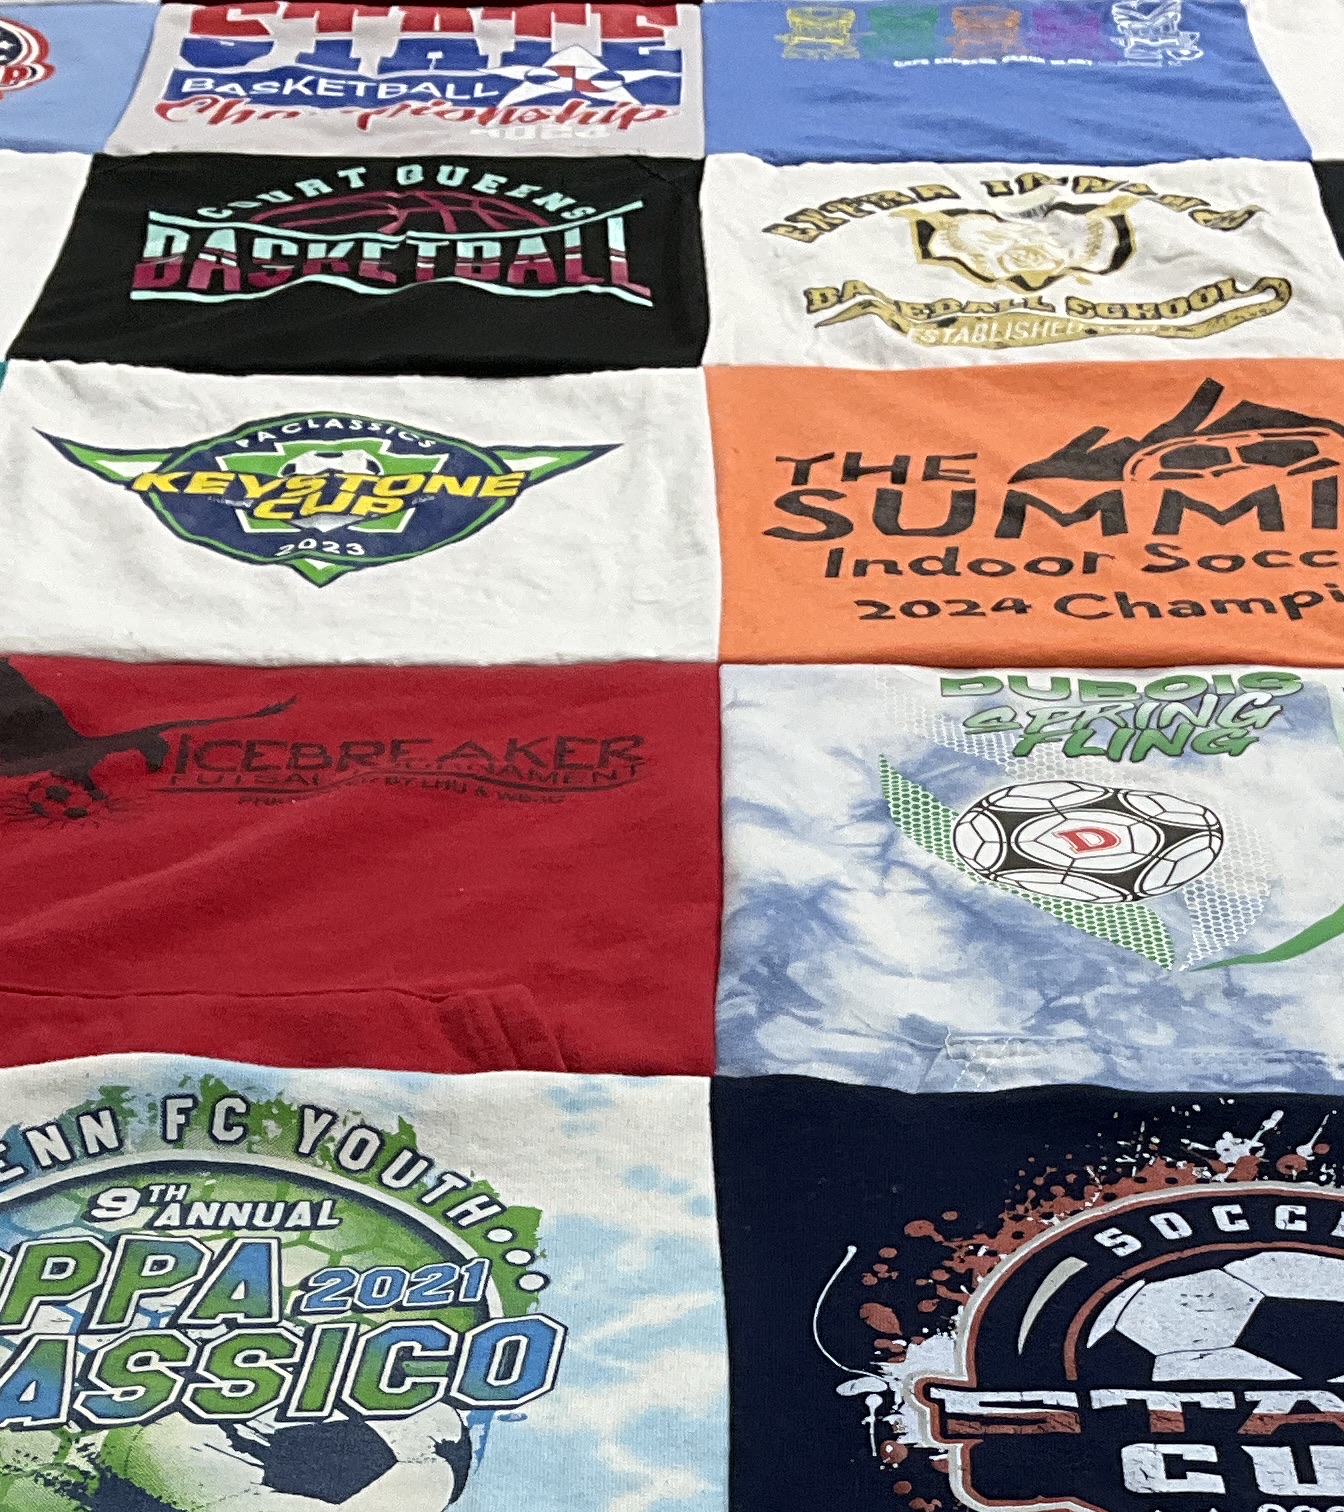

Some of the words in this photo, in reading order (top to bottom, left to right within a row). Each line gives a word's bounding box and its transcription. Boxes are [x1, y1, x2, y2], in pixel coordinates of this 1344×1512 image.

[180, 76, 501, 100] BASKETBALL
[156, 96, 674, 132] Chapionship
[197, 165, 367, 221] COURT
[395, 163, 598, 222] QUEENS
[762, 183, 959, 244] EXTRA
[131, 215, 651, 297] BASKETBALL
[803, 279, 1058, 322] BAEBALL
[1065, 277, 1244, 322] SCHOOL
[235, 427, 272, 448] PA
[278, 418, 438, 450] CLASSICS
[129, 470, 527, 498] KEYSTONE
[774, 451, 979, 487] THE
[252, 494, 406, 522] CUP
[274, 537, 366, 558] 2023
[822, 545, 1116, 579] Indoor
[853, 596, 1034, 621] 2024
[939, 671, 1305, 703] DUBOIS
[963, 692, 1284, 736] SPRING
[173, 732, 645, 777] ICEBREAKER
[1013, 723, 1260, 763] FLING
[1055, 827, 1123, 856] D
[162, 1094, 252, 1145] FC
[300, 1102, 504, 1229] YOUTH
[151, 1196, 343, 1233] ANNUAL
[296, 1255, 494, 1317] 2021
